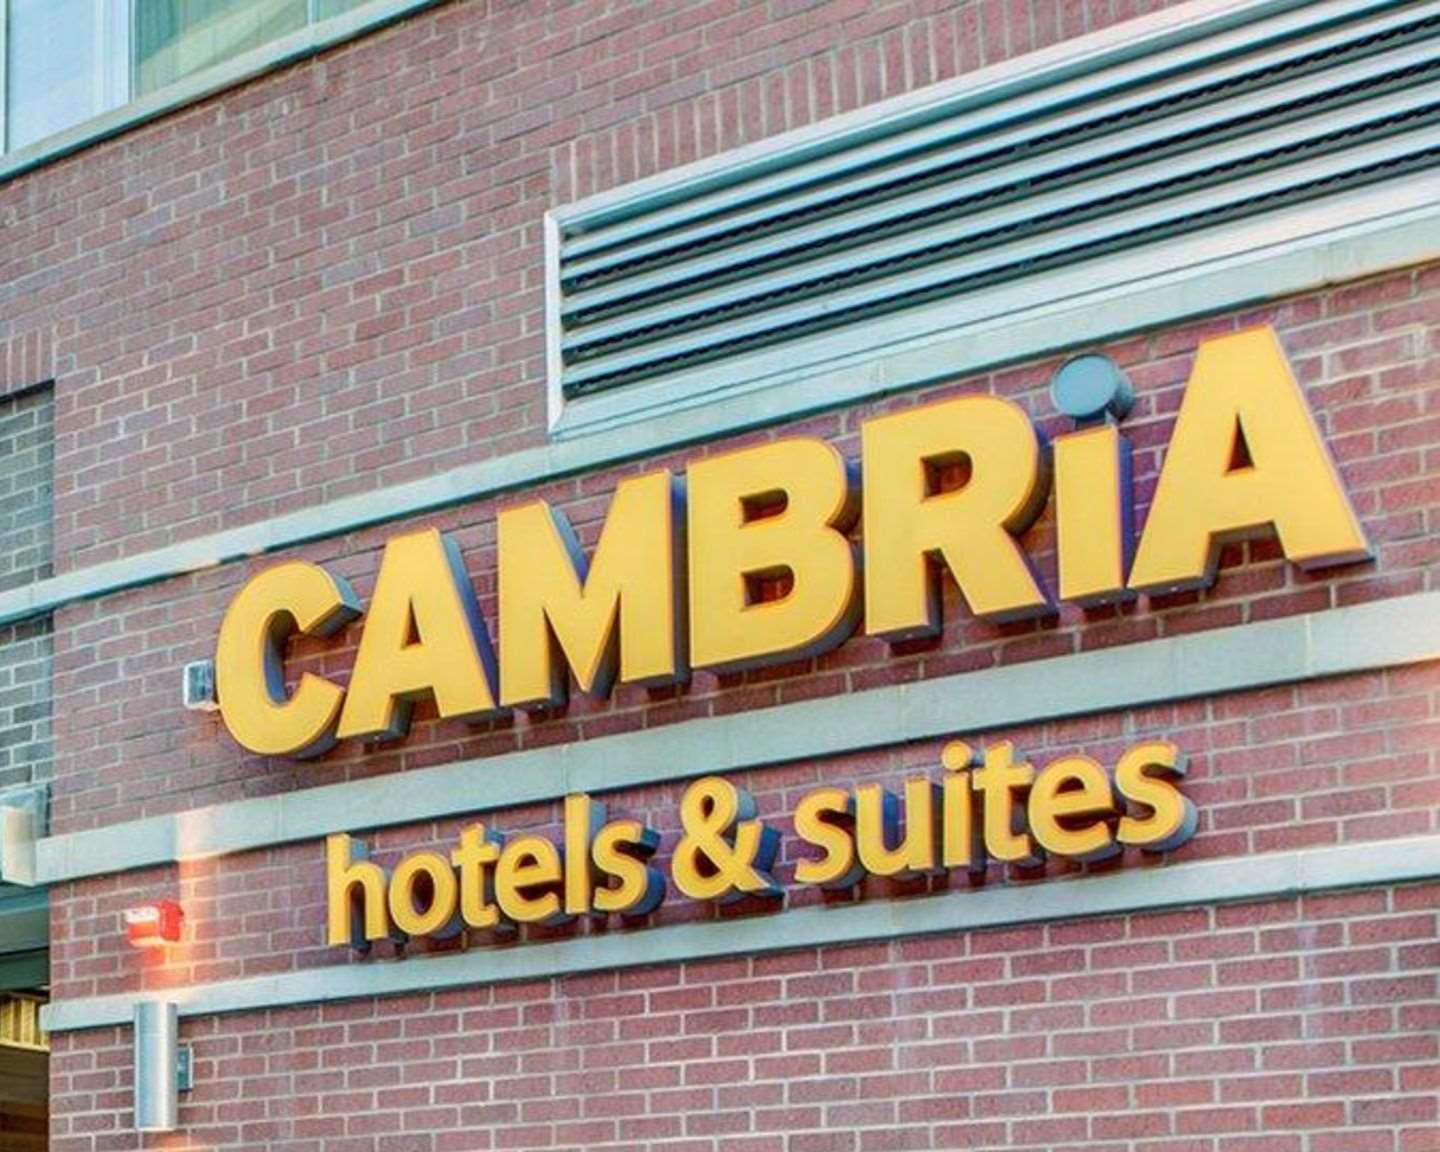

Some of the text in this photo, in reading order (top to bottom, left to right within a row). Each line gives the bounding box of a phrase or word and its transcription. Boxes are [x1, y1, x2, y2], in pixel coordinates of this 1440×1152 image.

[326, 739, 1185, 948] hotels & suites
